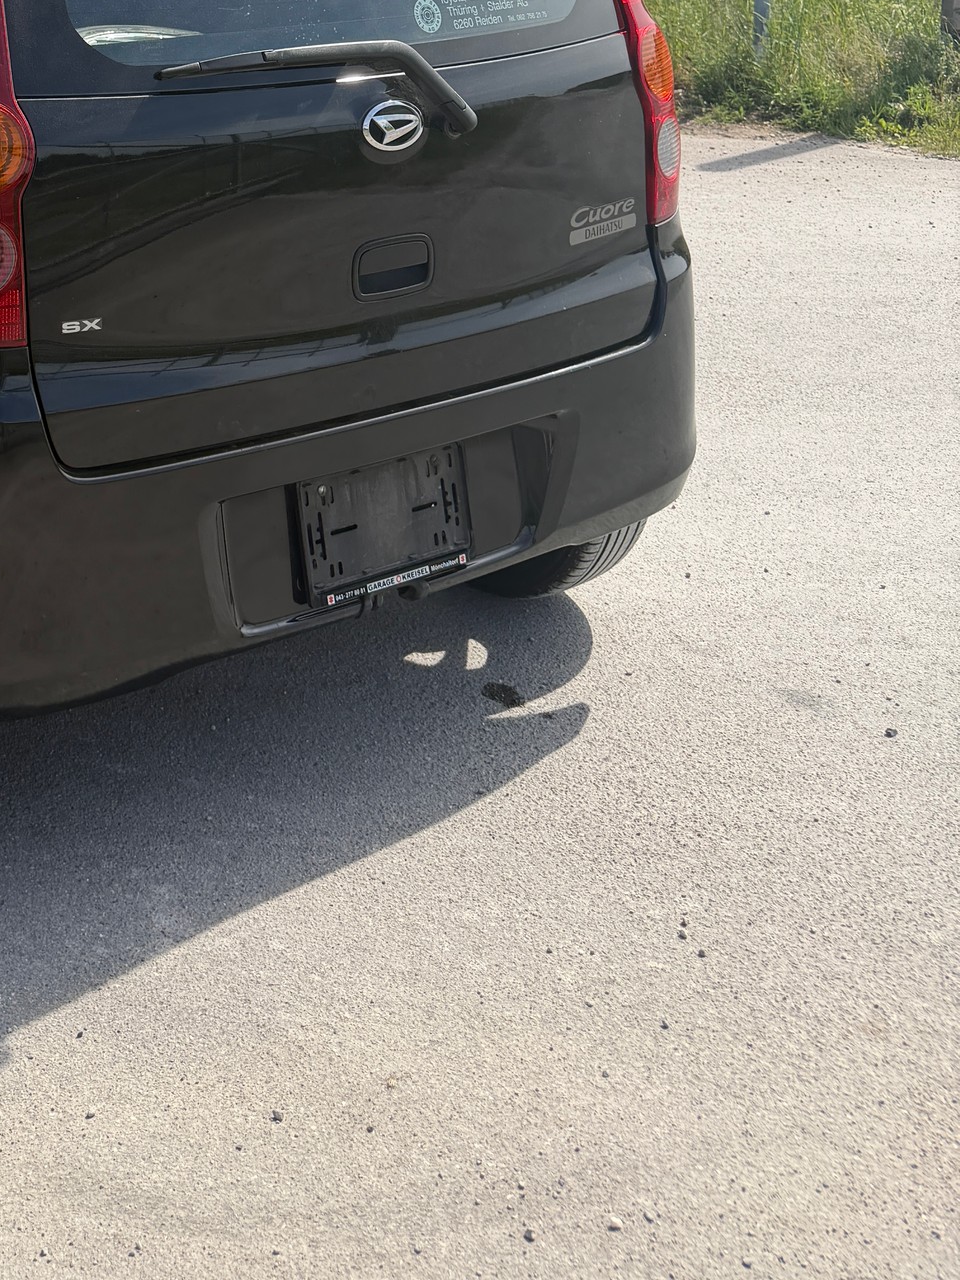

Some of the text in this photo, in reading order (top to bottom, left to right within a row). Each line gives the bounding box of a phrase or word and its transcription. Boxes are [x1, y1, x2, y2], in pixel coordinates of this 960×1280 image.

[447, 4, 478, 17] Thüring
[486, 0, 514, 12] Stalder
[453, 18, 474, 30] 6260
[476, 15, 503, 27] Reiden
[570, 198, 635, 228] Cuore
[584, 218, 623, 240] DAIHATSU
[62, 317, 102, 334] SX
[368, 577, 395, 592] GARAGE
[401, 567, 429, 581] KREISEL
